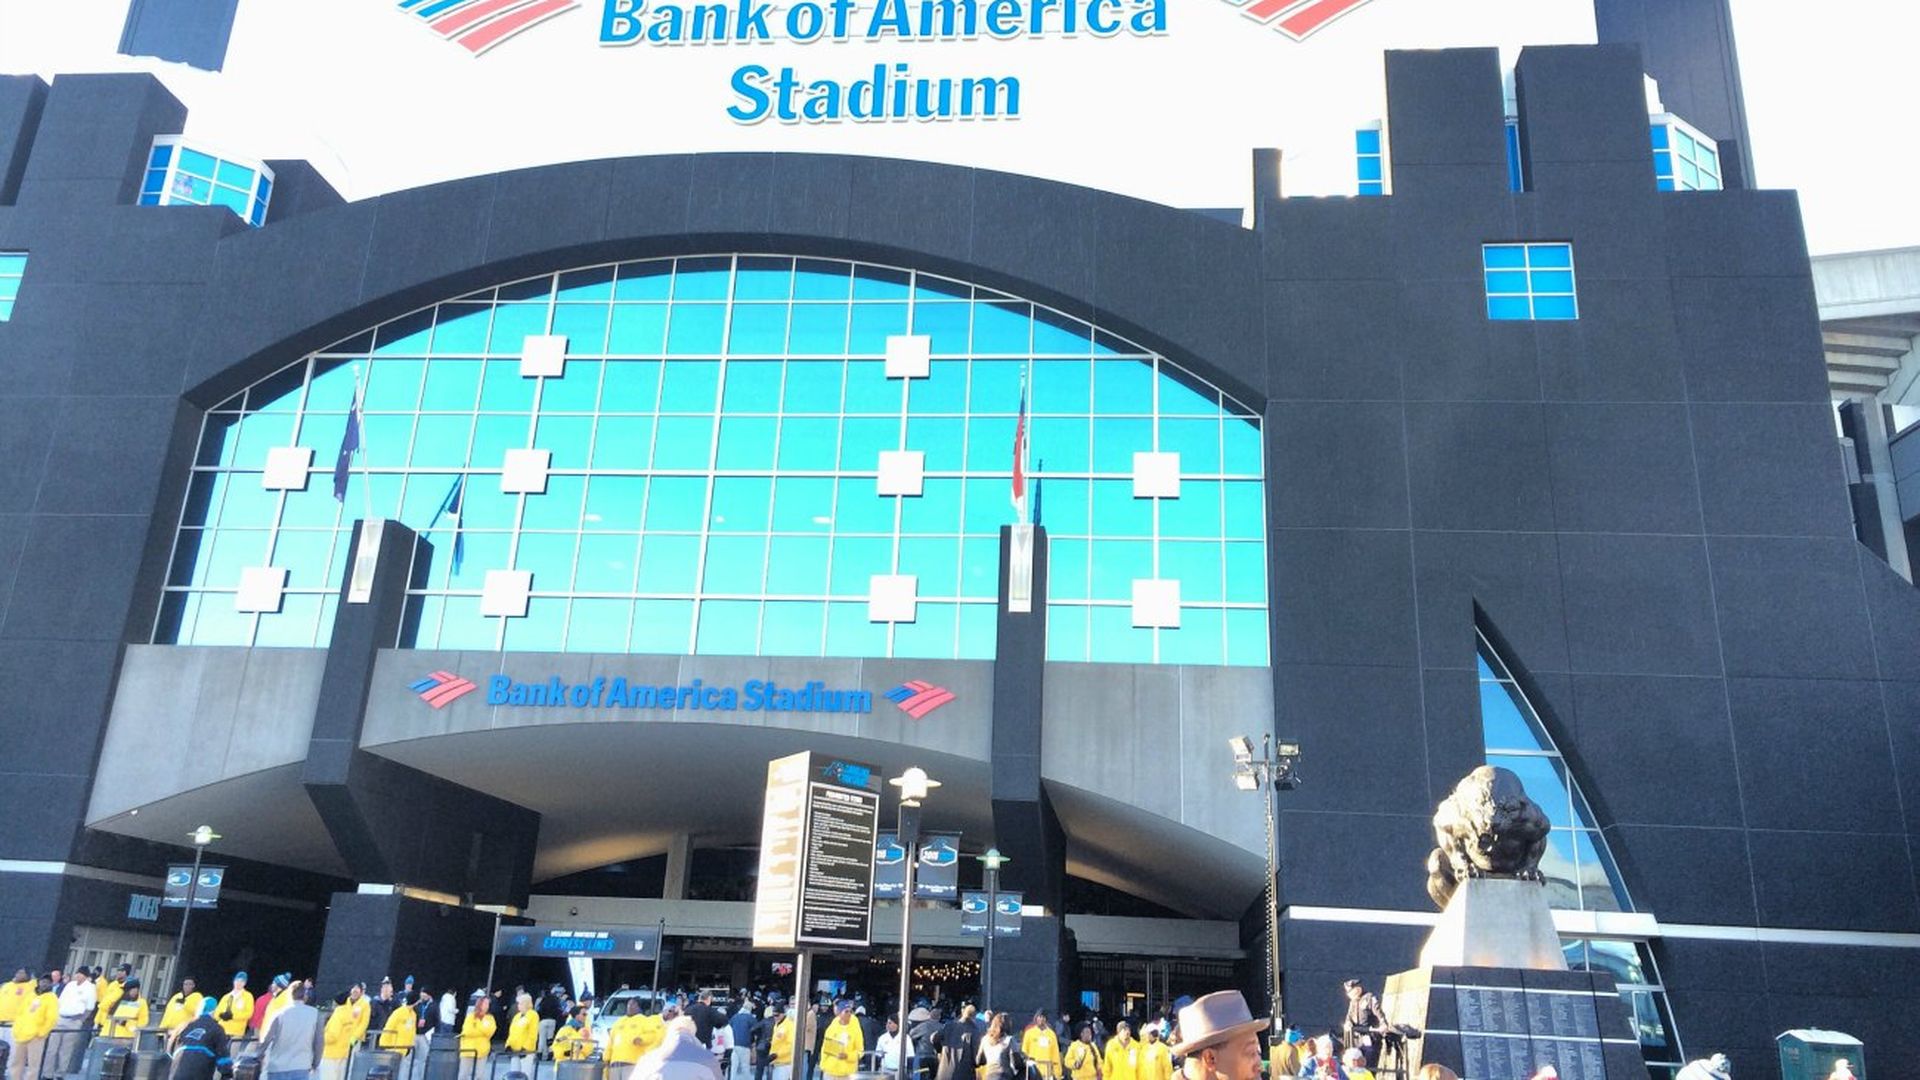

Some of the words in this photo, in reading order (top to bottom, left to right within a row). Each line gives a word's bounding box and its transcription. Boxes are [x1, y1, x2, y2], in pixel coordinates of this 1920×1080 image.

[598, 0, 771, 44] Bank
[785, 0, 856, 41] of
[866, 0, 1169, 38] America
[726, 63, 1020, 121] Stadium
[488, 675, 567, 706] Bank
[570, 676, 606, 708] of
[606, 676, 738, 711] America
[743, 679, 872, 714] Stadium
